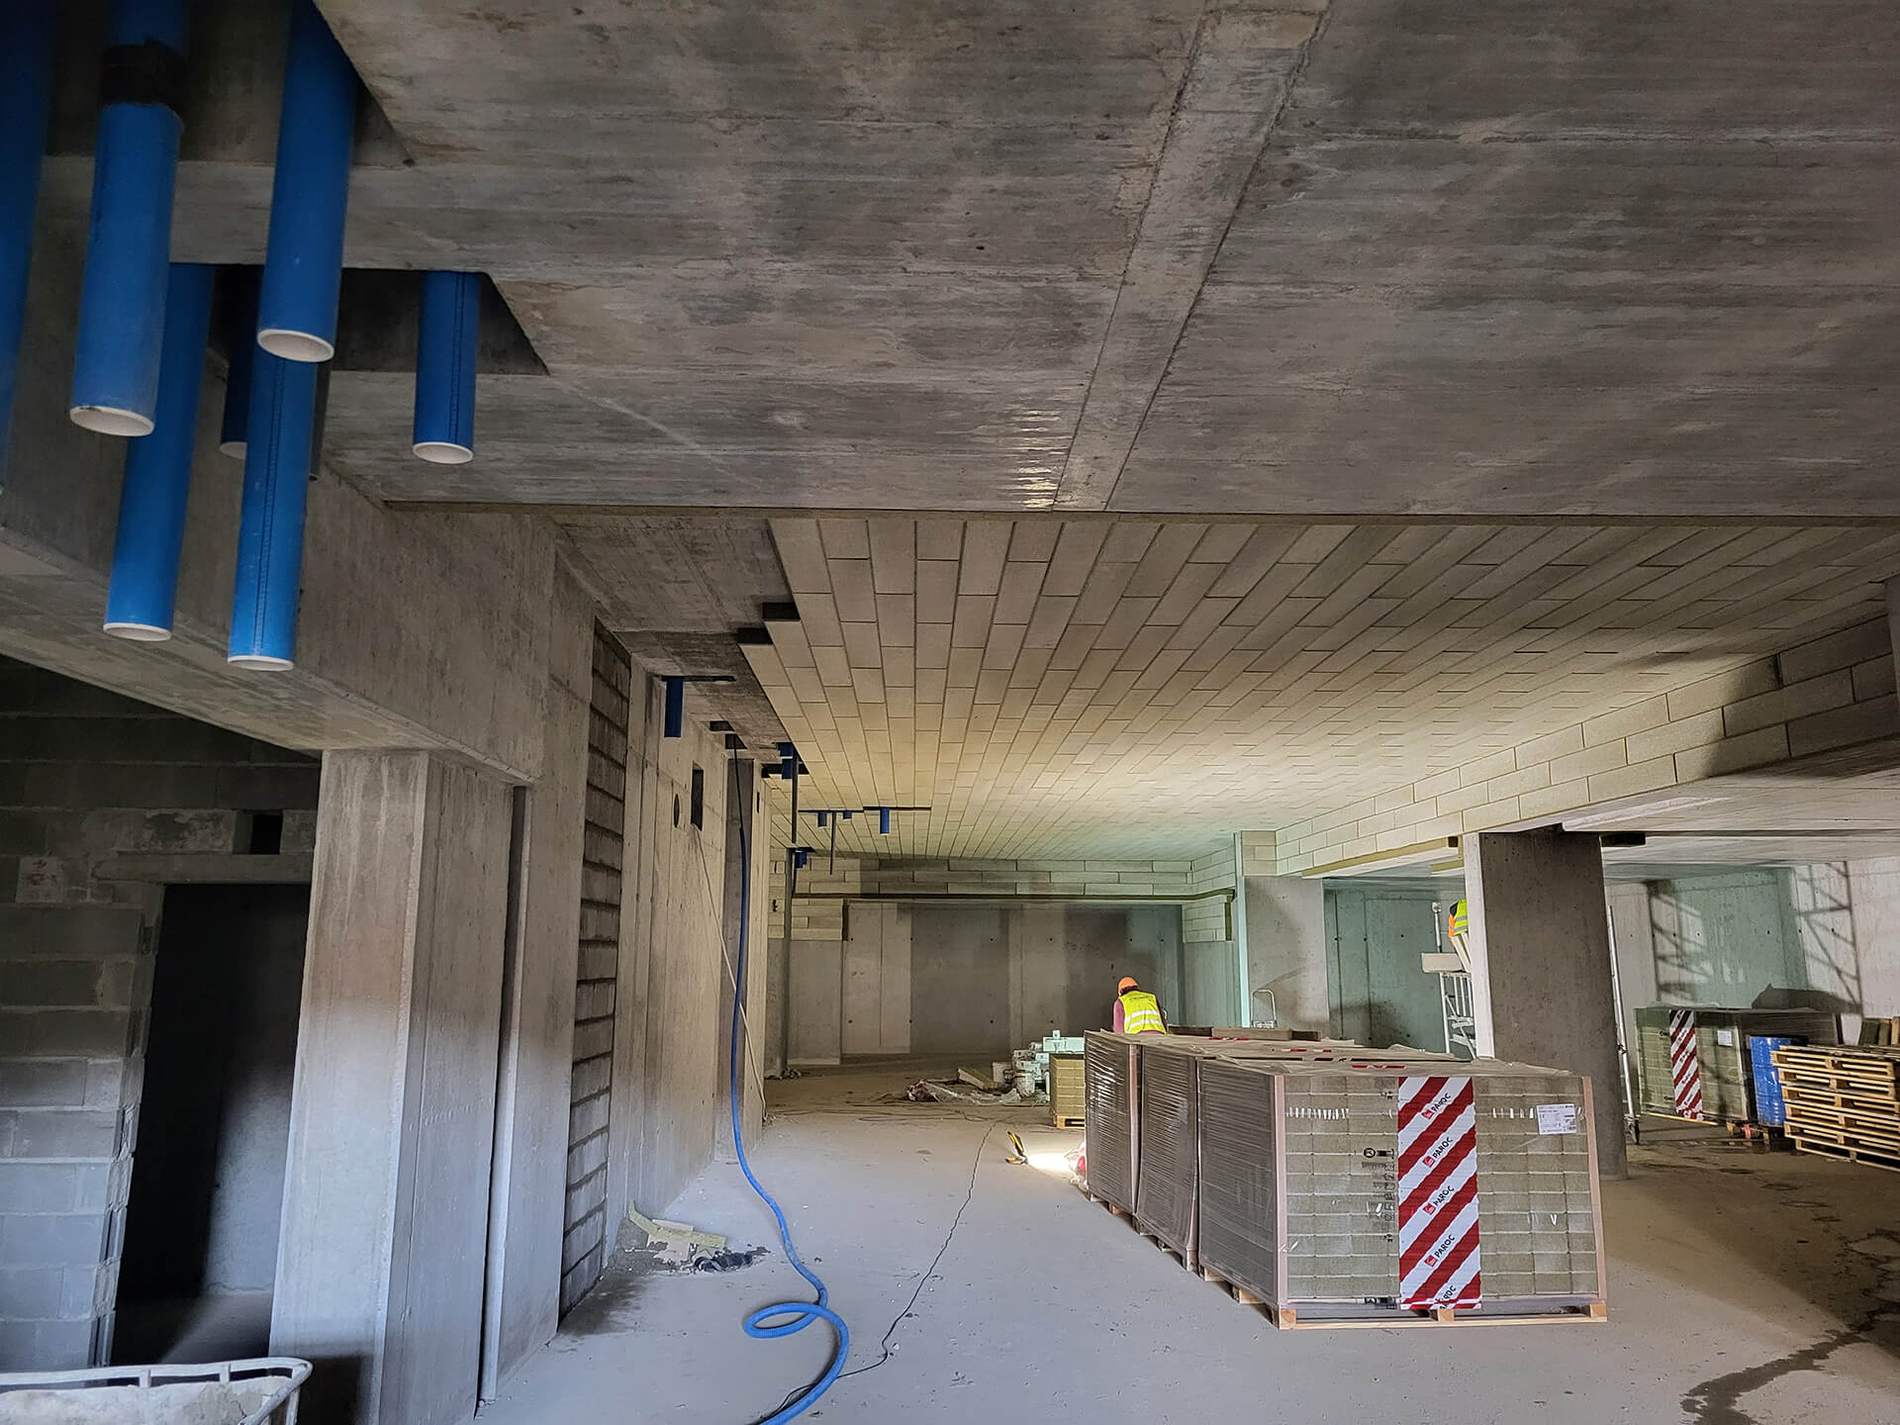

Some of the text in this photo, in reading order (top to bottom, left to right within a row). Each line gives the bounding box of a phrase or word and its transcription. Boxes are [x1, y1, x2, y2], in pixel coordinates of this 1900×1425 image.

[1432, 1137, 1454, 1159] PAROC
[1433, 1185, 1455, 1207] PAROC
[1434, 1234, 1456, 1258] PAROC
